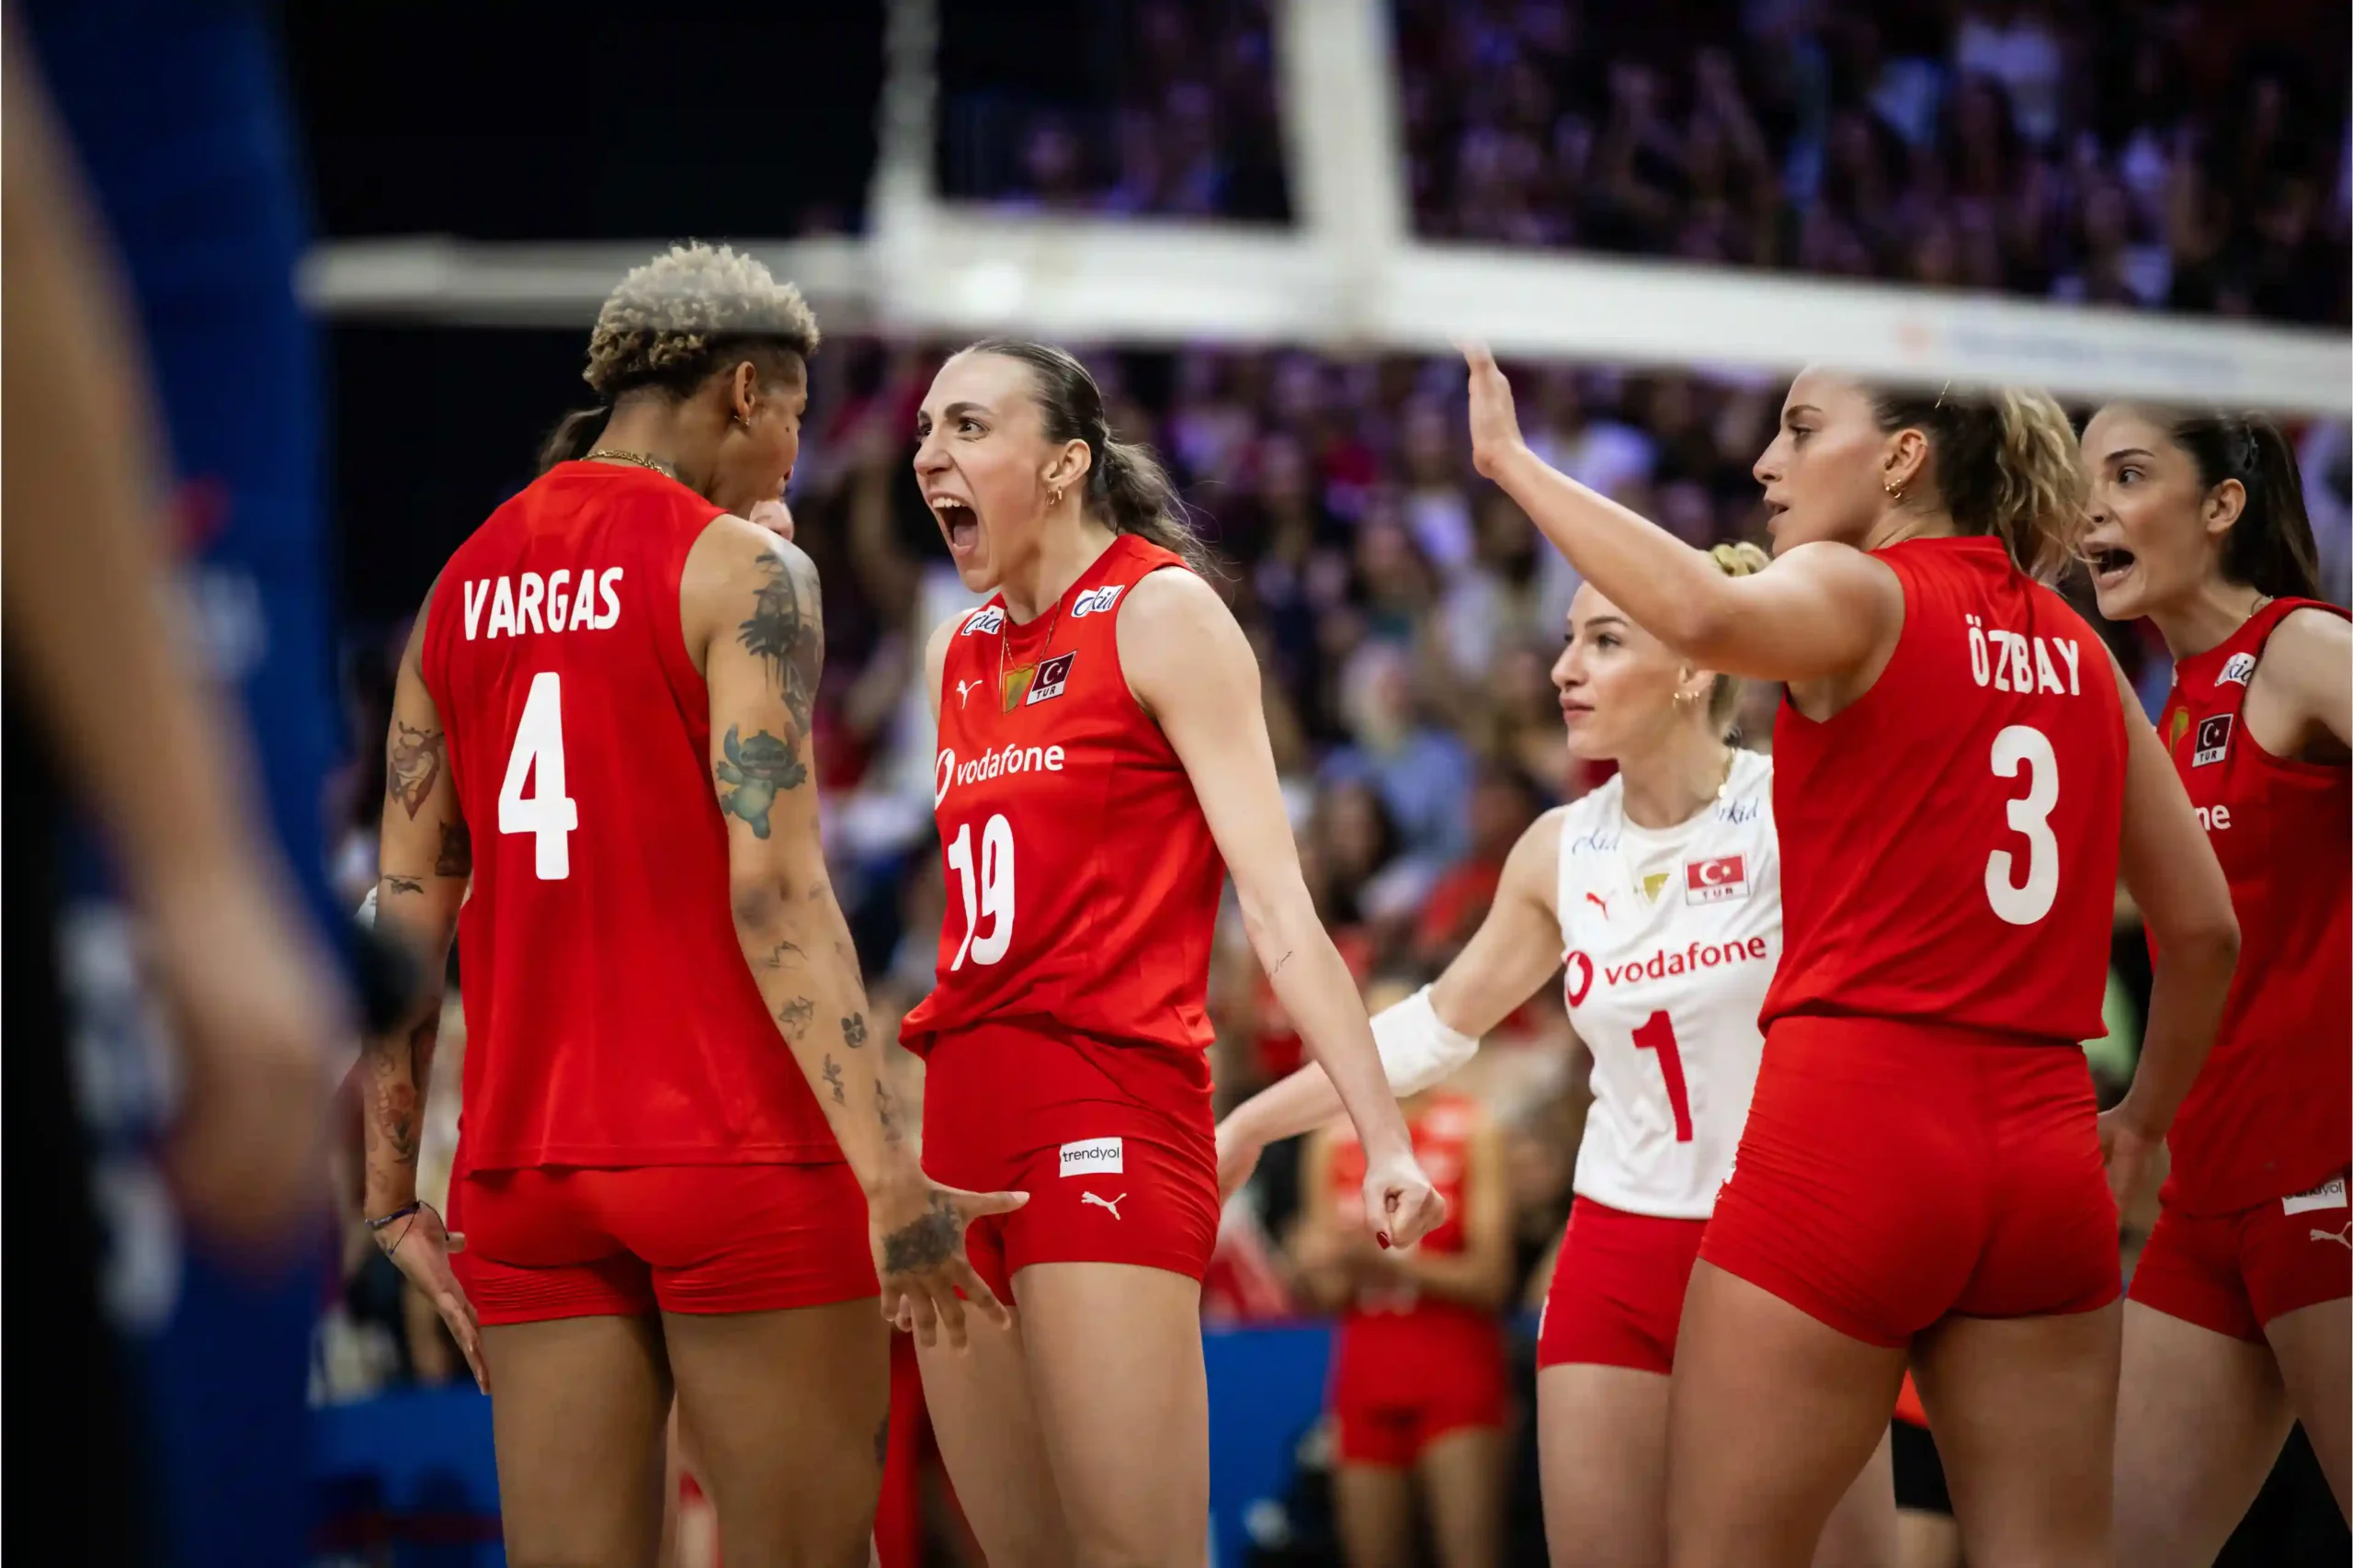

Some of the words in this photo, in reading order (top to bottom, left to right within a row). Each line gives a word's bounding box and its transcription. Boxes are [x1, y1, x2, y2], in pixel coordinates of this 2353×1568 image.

[463, 566, 624, 641] VARGAS
[1965, 613, 2080, 696] ÖZBAY
[1036, 685, 1056, 699] TUR
[498, 671, 578, 880] 4
[957, 743, 1065, 787] vodafone
[2200, 750, 2217, 762] TUR
[1984, 724, 2059, 925] 3
[948, 813, 1015, 971] 19
[1702, 887, 1733, 900] TUR
[1605, 936, 1767, 985] vodafone
[1631, 1009, 1693, 1143] 1
[1062, 1146, 1120, 1164] trendyol
